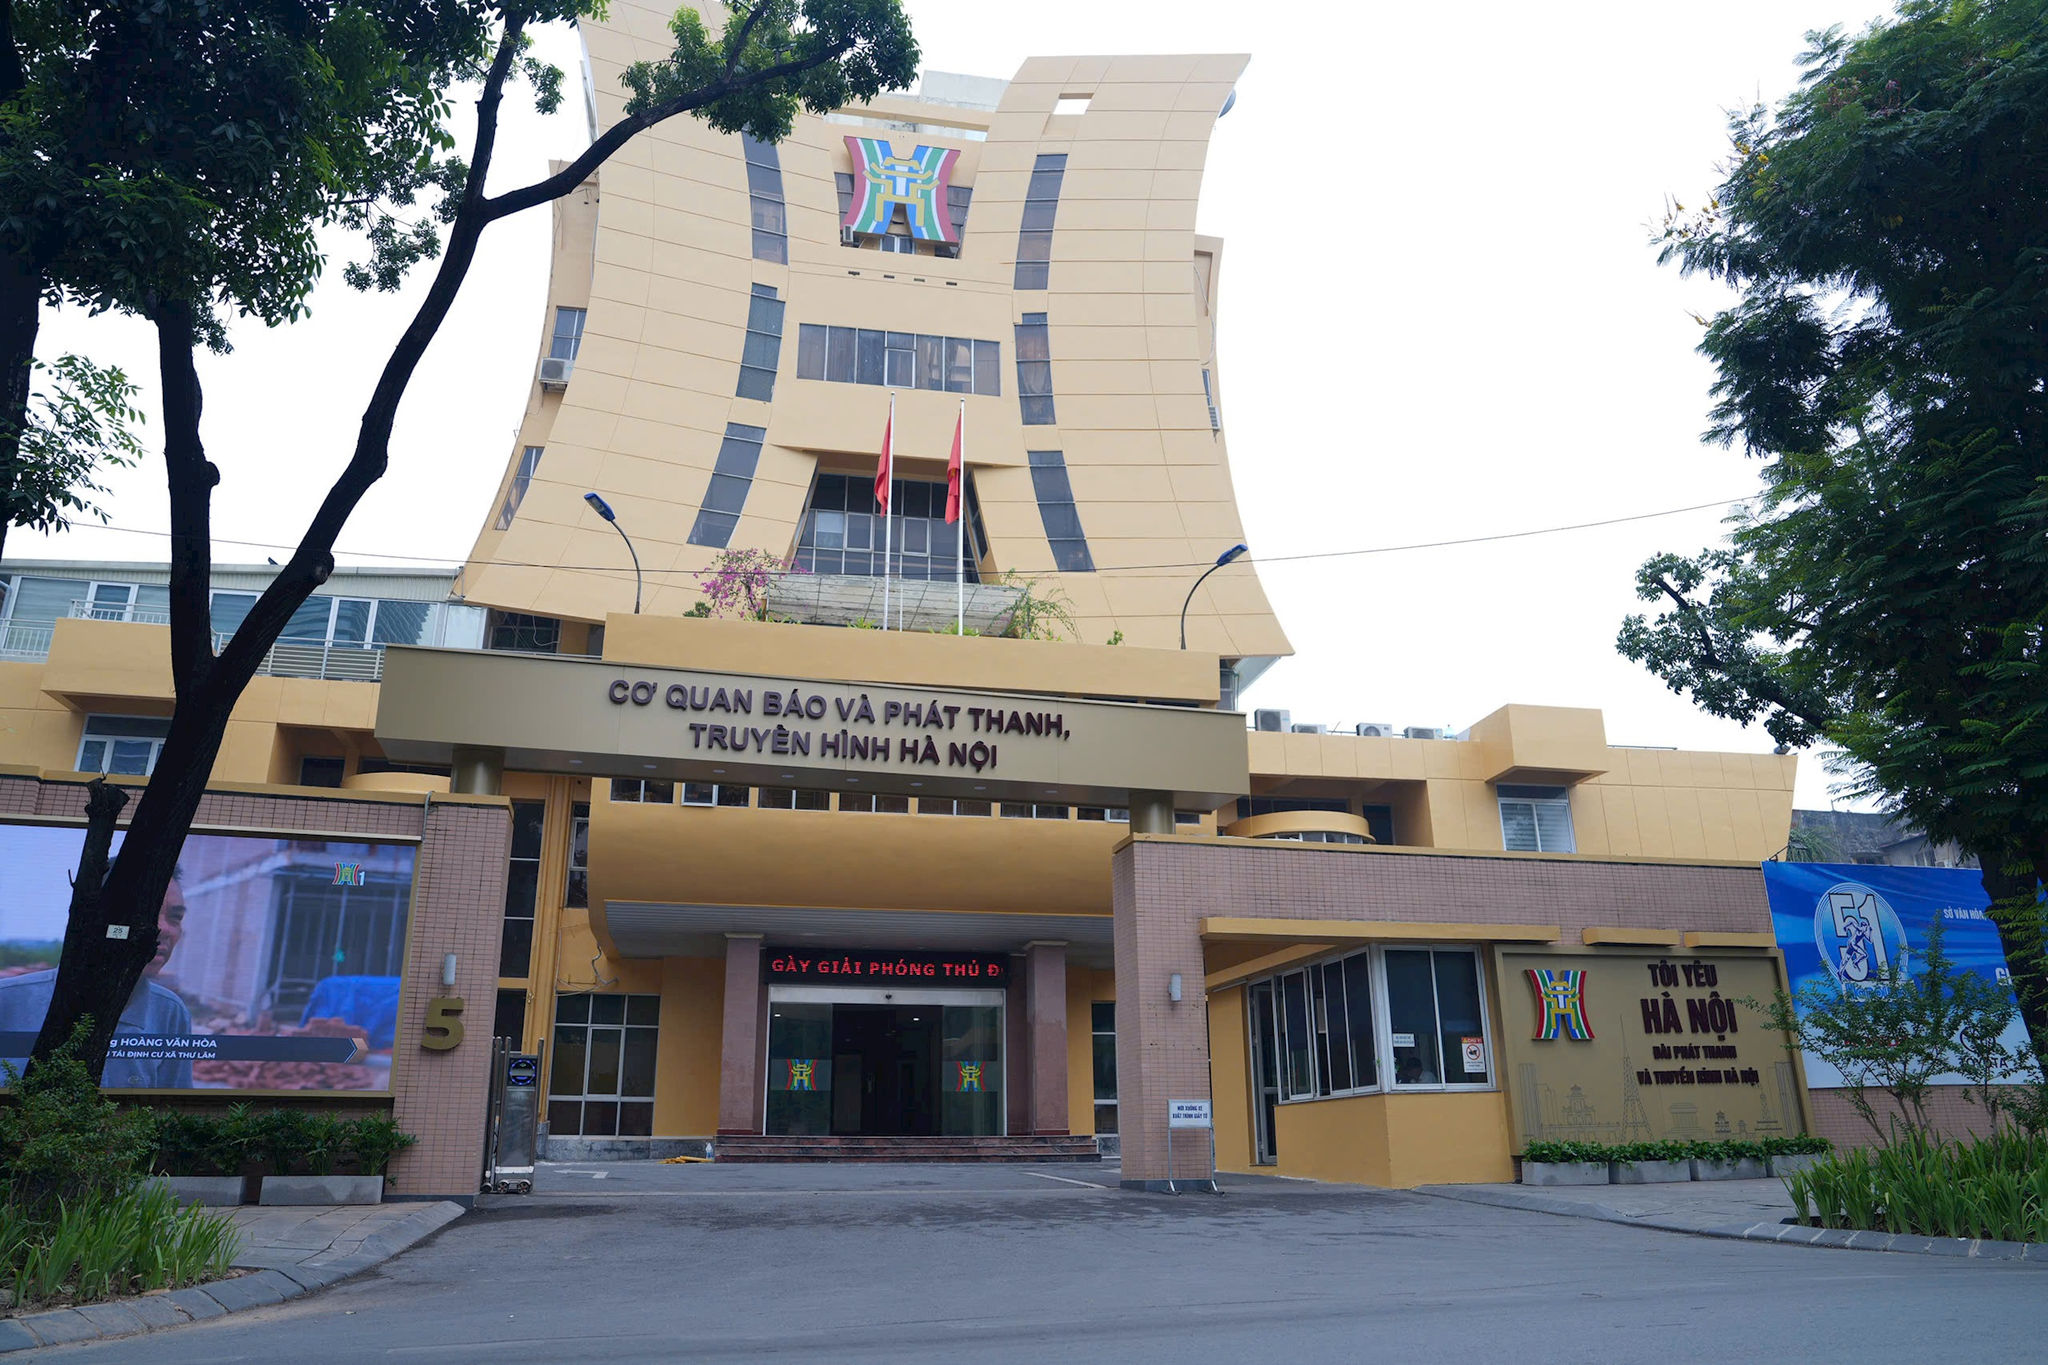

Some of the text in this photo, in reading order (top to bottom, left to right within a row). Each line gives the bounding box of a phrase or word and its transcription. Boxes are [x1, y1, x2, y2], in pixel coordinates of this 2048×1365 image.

[609, 680, 1070, 741] CƠ QUAN BÁO VÀ PHÁT THANH,
[689, 724, 997, 773] TRUYỀN HÌNH HÀ NỘI
[817, 957, 862, 975] GIẢI
[869, 959, 935, 976] PHÓNG
[942, 959, 980, 977] THỦ
[987, 963, 1003, 977] Đ
[1647, 960, 1718, 988] TÔI YÊU
[420, 996, 464, 1051] 5
[1640, 991, 1738, 1041] HÀ NỘI
[120, 1036, 163, 1047] HOÀNG
[165, 1037, 189, 1048] VĂN
[192, 1039, 217, 1048] HÒA
[1673, 1043, 1700, 1060] PHÁT
[1702, 1045, 1737, 1060] THANH
[112, 1050, 126, 1058] TÁI
[127, 1051, 149, 1059] ĐỊNH
[179, 1051, 197, 1059] THƯ
[197, 1051, 216, 1059] LÂM
[1636, 1068, 1653, 1085] VÀ
[1696, 1067, 1722, 1084] HÌNH
[1723, 1067, 1740, 1084] HÀ
[1740, 1067, 1760, 1087] NỘI
